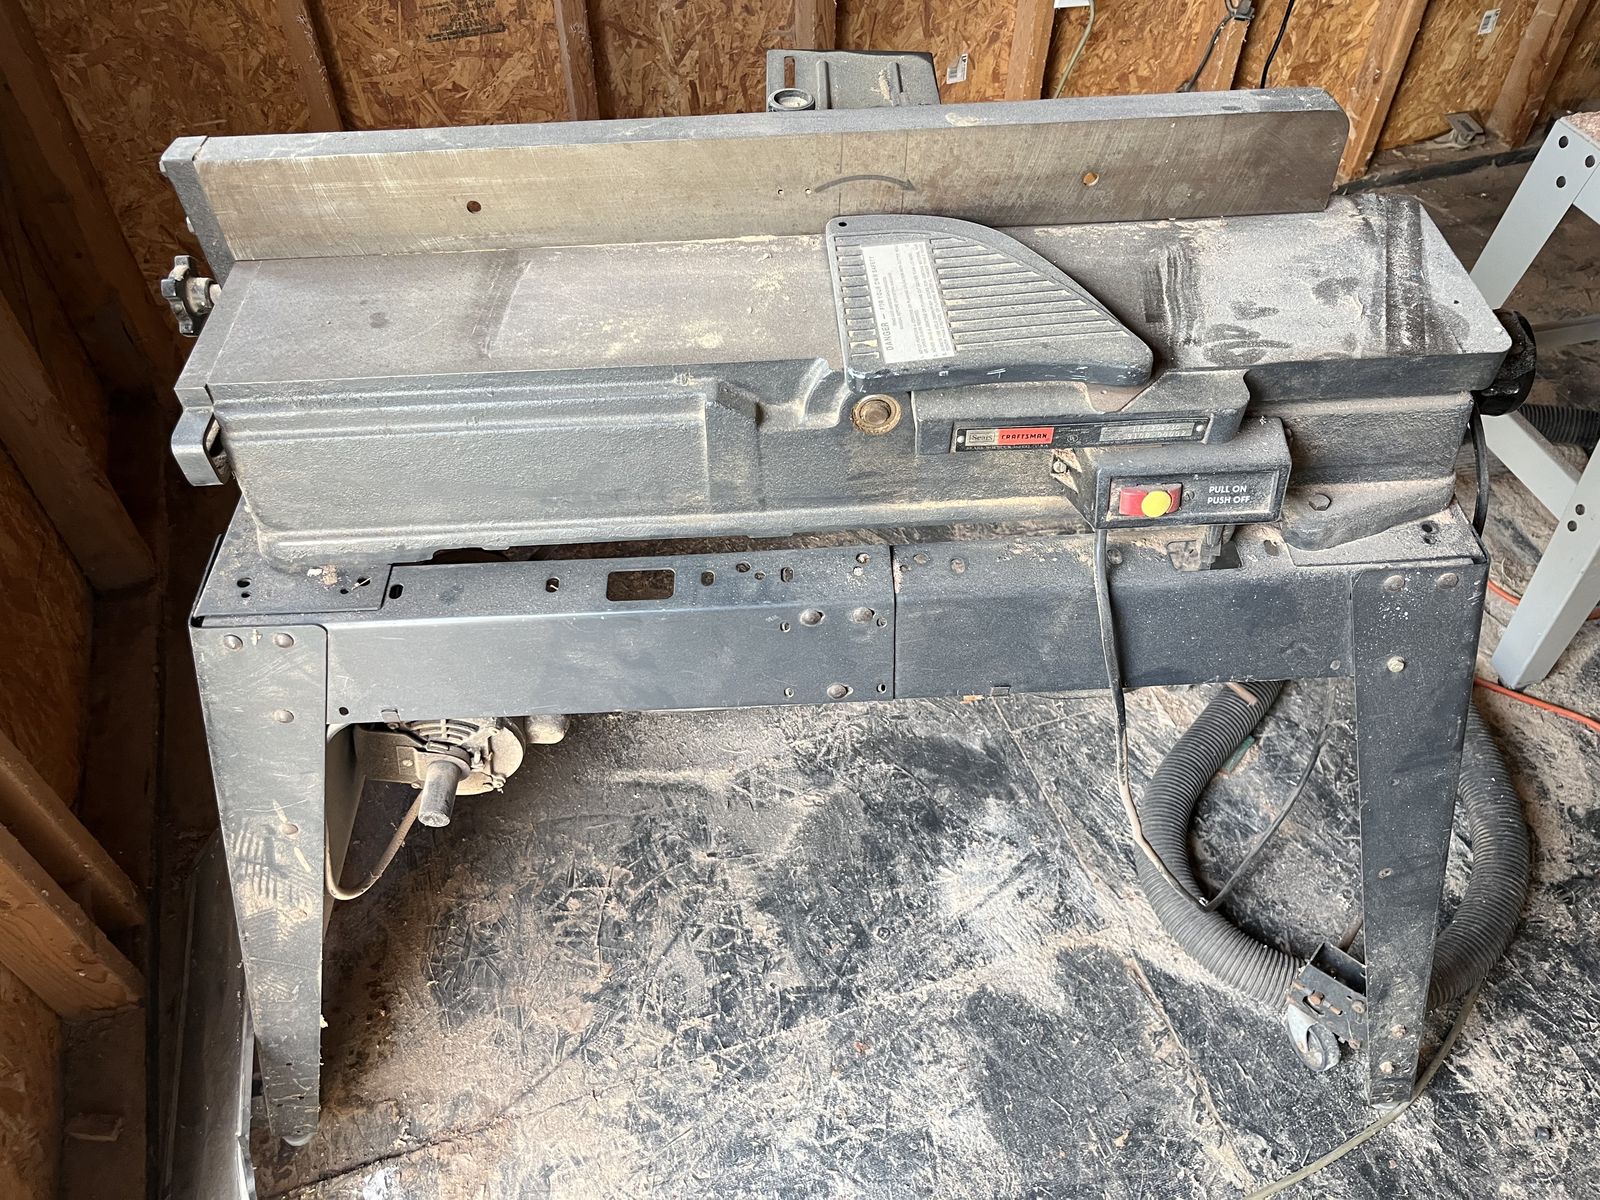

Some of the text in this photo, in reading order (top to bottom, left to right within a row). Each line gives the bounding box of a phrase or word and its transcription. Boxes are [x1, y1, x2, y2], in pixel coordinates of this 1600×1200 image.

[880, 322, 894, 350] DANGER
[1232, 485, 1247, 493] ON
[1208, 496, 1250, 504] PUSH OFF
